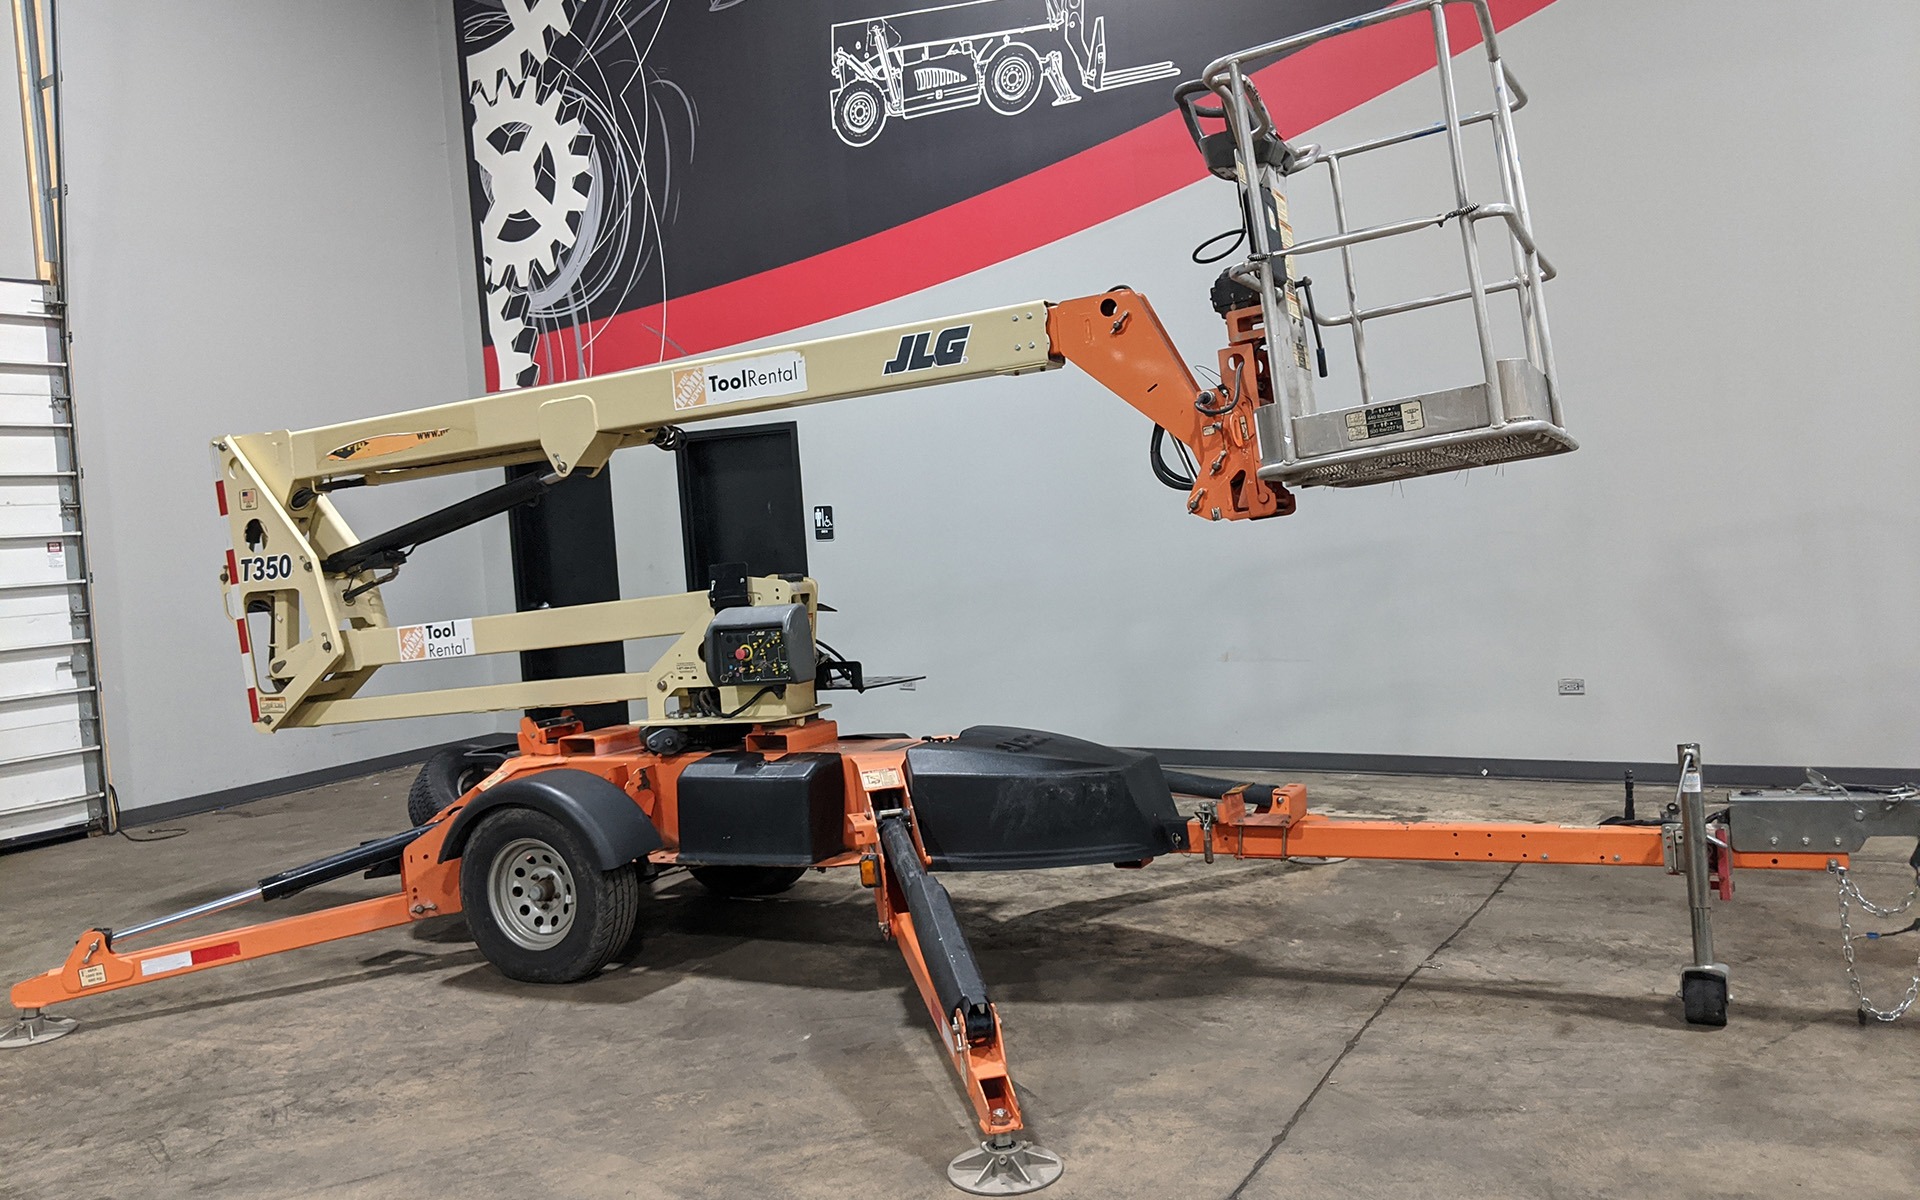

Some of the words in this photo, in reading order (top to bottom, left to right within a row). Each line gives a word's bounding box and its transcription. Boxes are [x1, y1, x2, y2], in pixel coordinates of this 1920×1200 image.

[882, 324, 972, 375] JLG
[240, 554, 292, 582] T350
[425, 621, 455, 639] Tool
[428, 638, 467, 657] Rental
